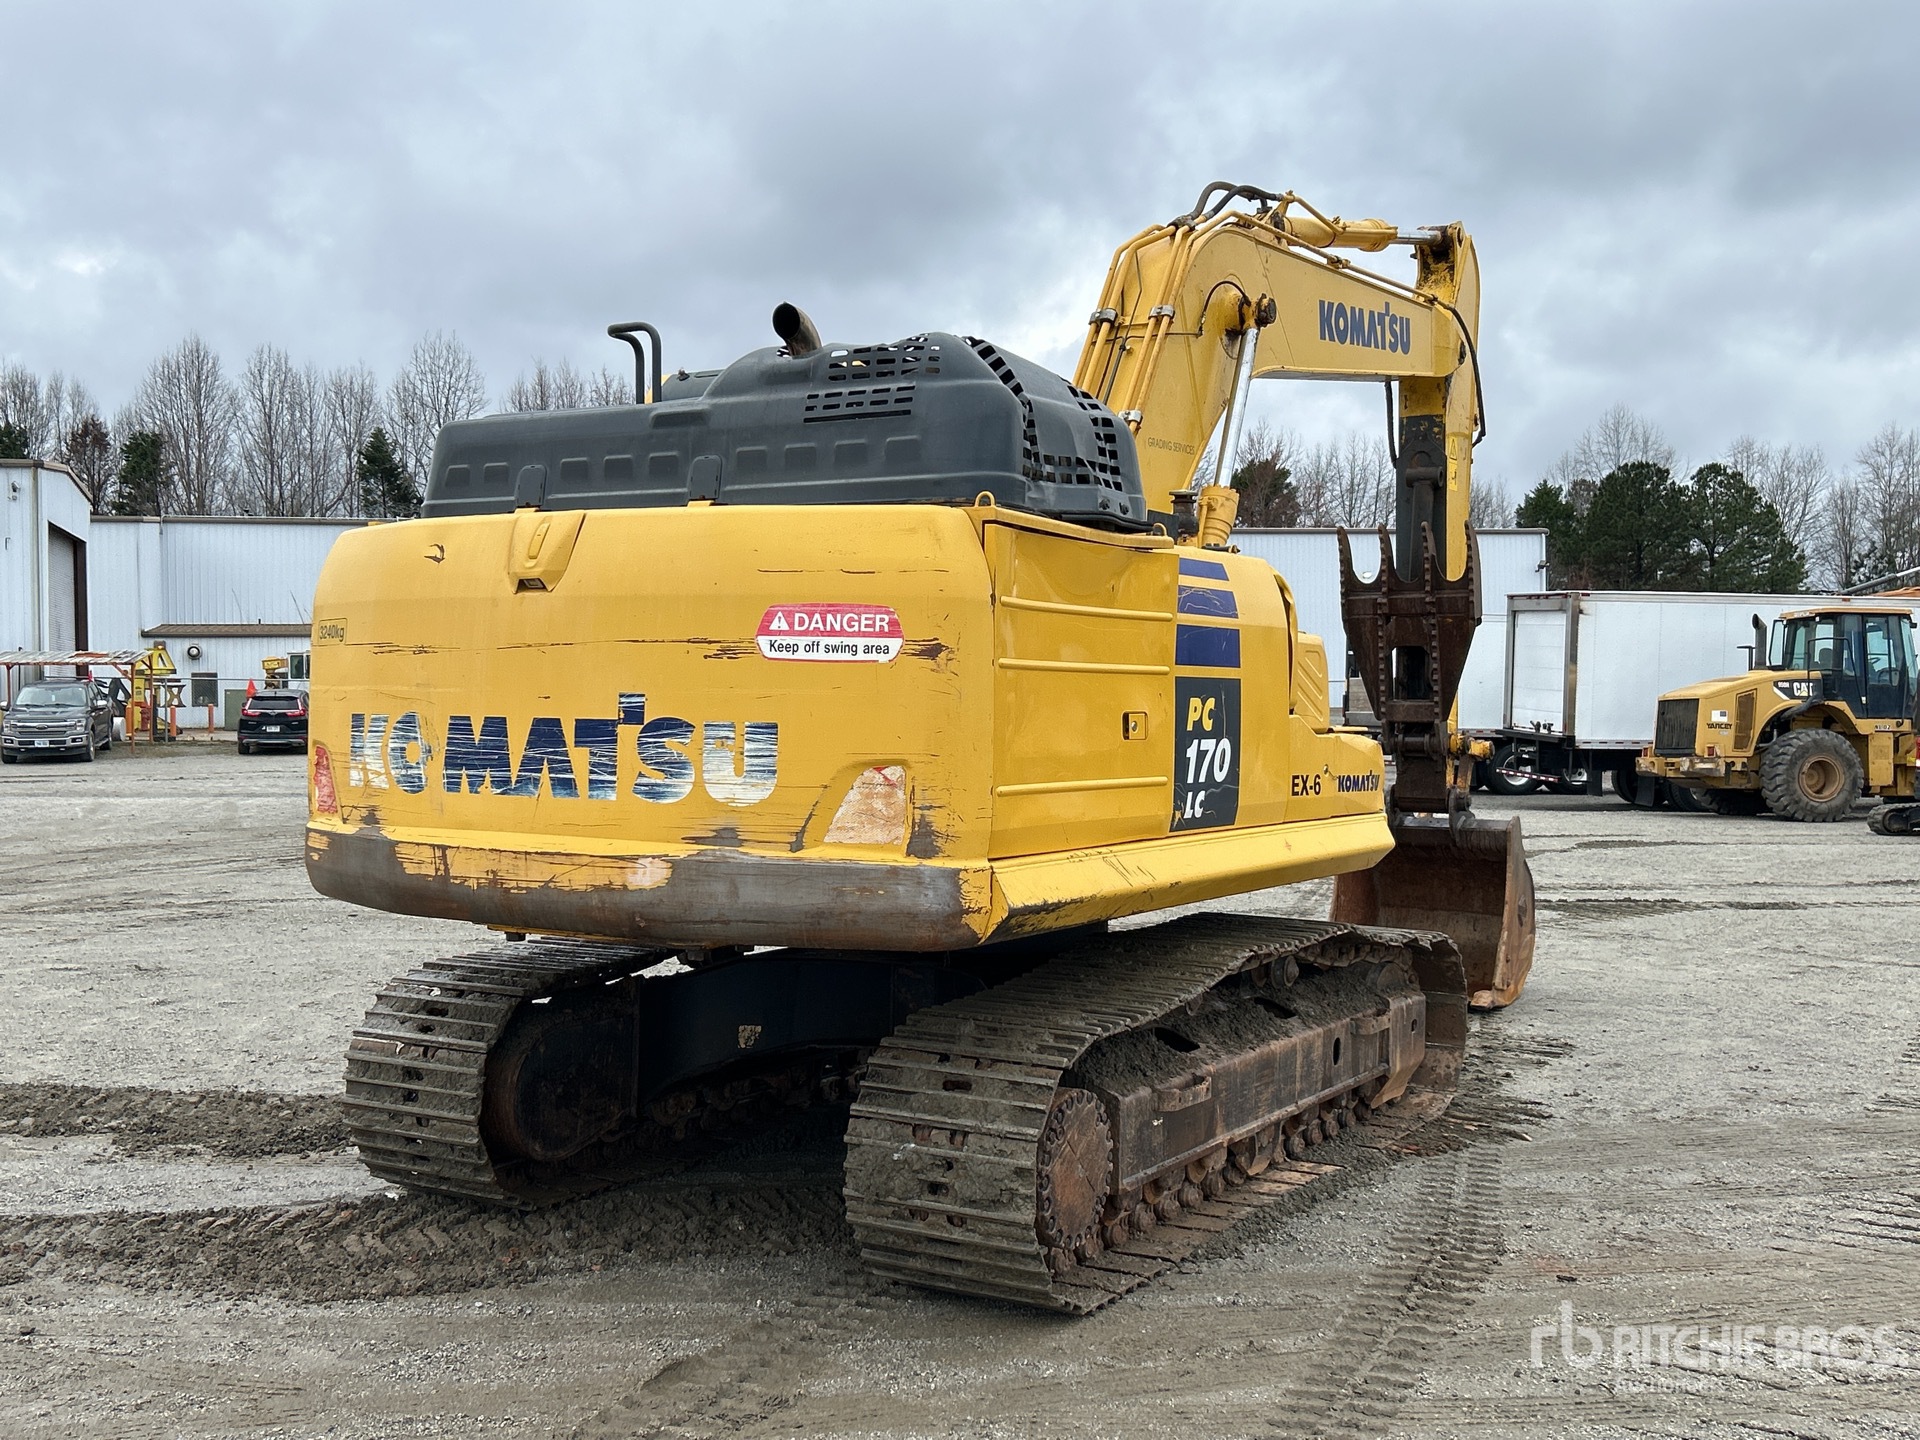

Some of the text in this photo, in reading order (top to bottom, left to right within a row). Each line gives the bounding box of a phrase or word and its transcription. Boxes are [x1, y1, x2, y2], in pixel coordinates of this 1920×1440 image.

[1318, 300, 1411, 355] KOMATSU
[1147, 436, 1172, 451] GRADING
[320, 624, 345, 642] 3240kg
[793, 612, 890, 633] DANGER
[769, 639, 890, 656] Keep off swing area
[1793, 682, 1813, 697] CAT
[1186, 697, 1216, 732] PC
[350, 693, 779, 806] KOMATSU
[1186, 737, 1232, 784] 170
[1291, 769, 1380, 796] EX-6 KOMATSU
[1184, 790, 1206, 819] LC
